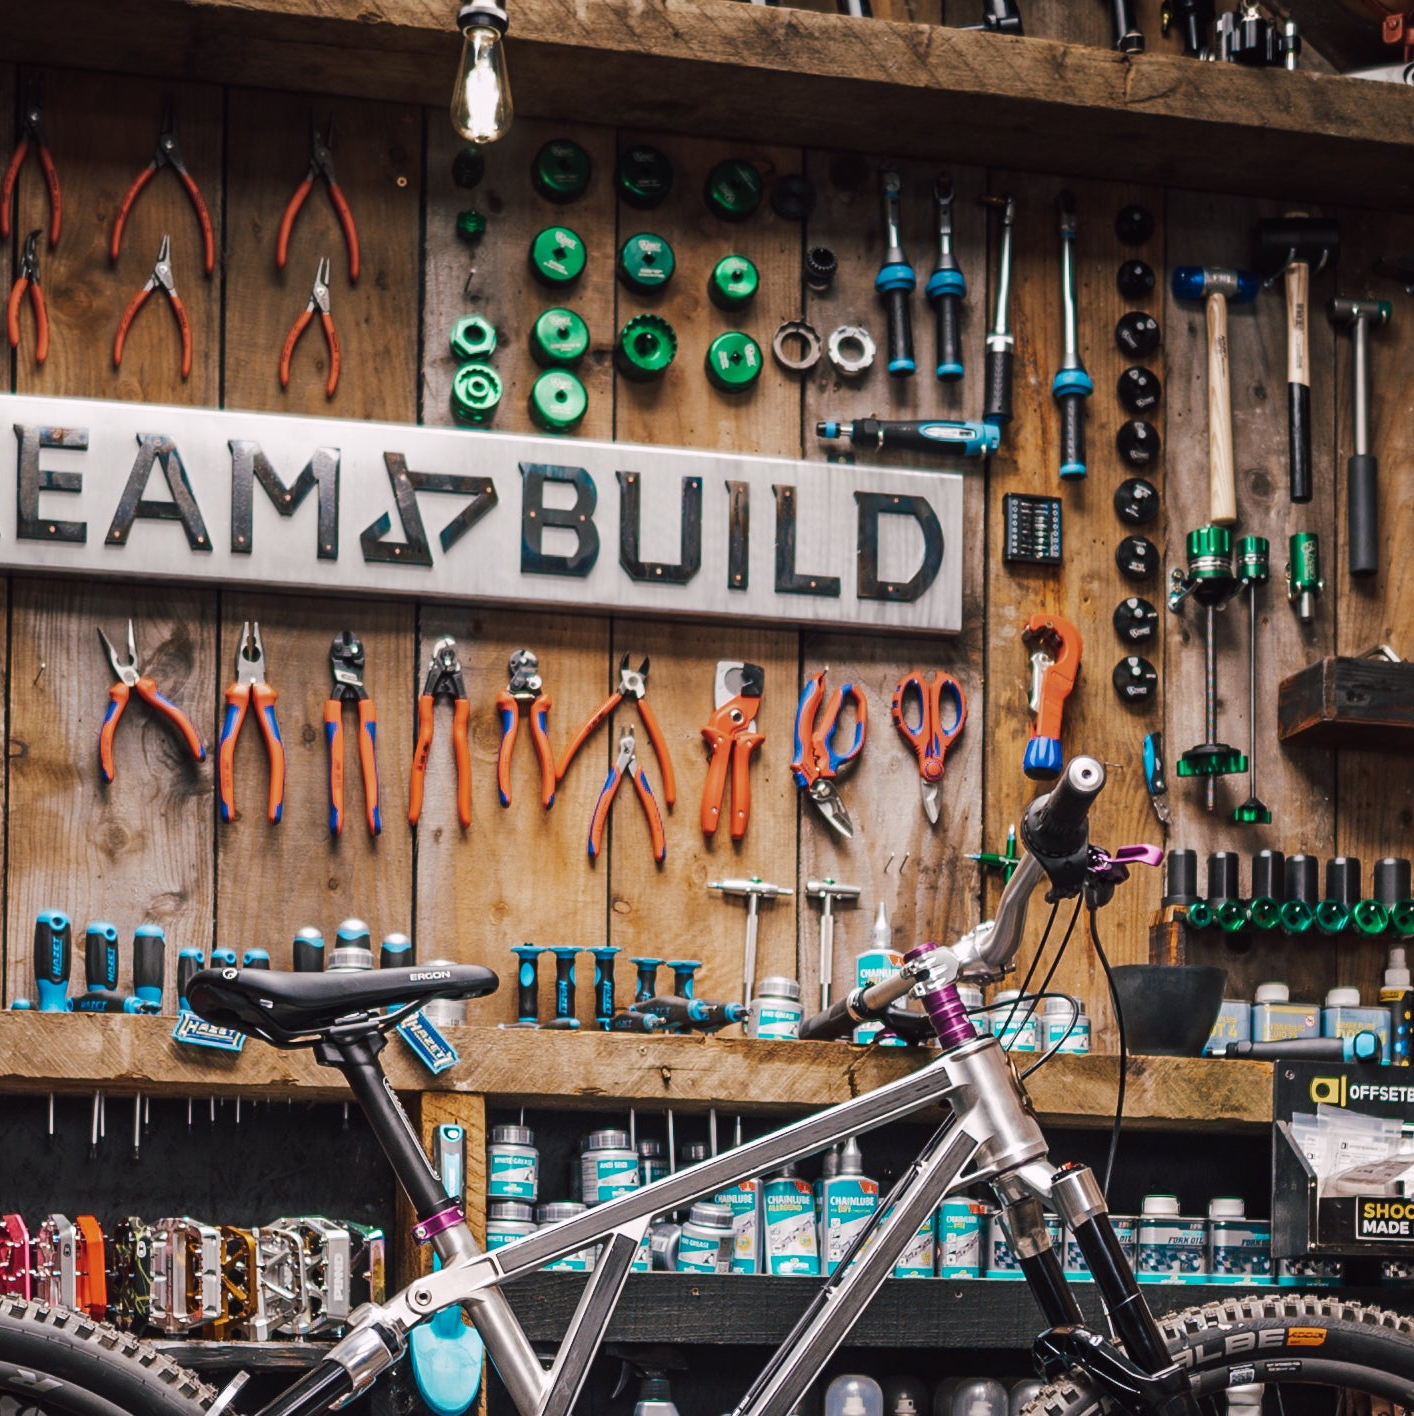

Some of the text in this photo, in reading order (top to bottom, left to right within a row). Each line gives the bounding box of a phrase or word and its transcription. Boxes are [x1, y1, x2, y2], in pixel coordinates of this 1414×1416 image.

[519, 462, 945, 601] BUILD
[51, 937, 64, 977] HAZET
[105, 947, 116, 984] HAZET
[409, 970, 451, 981] ERGON
[559, 979, 569, 1015] HAZET
[603, 979, 613, 1015] HAZET
[186, 1018, 238, 1040] HAZET
[407, 1016, 448, 1062] HAZET
[768, 1196, 810, 1206] CHAINLUBE
[830, 1196, 874, 1206] CHAINLUBE
[1362, 1220, 1410, 1235] MADE
